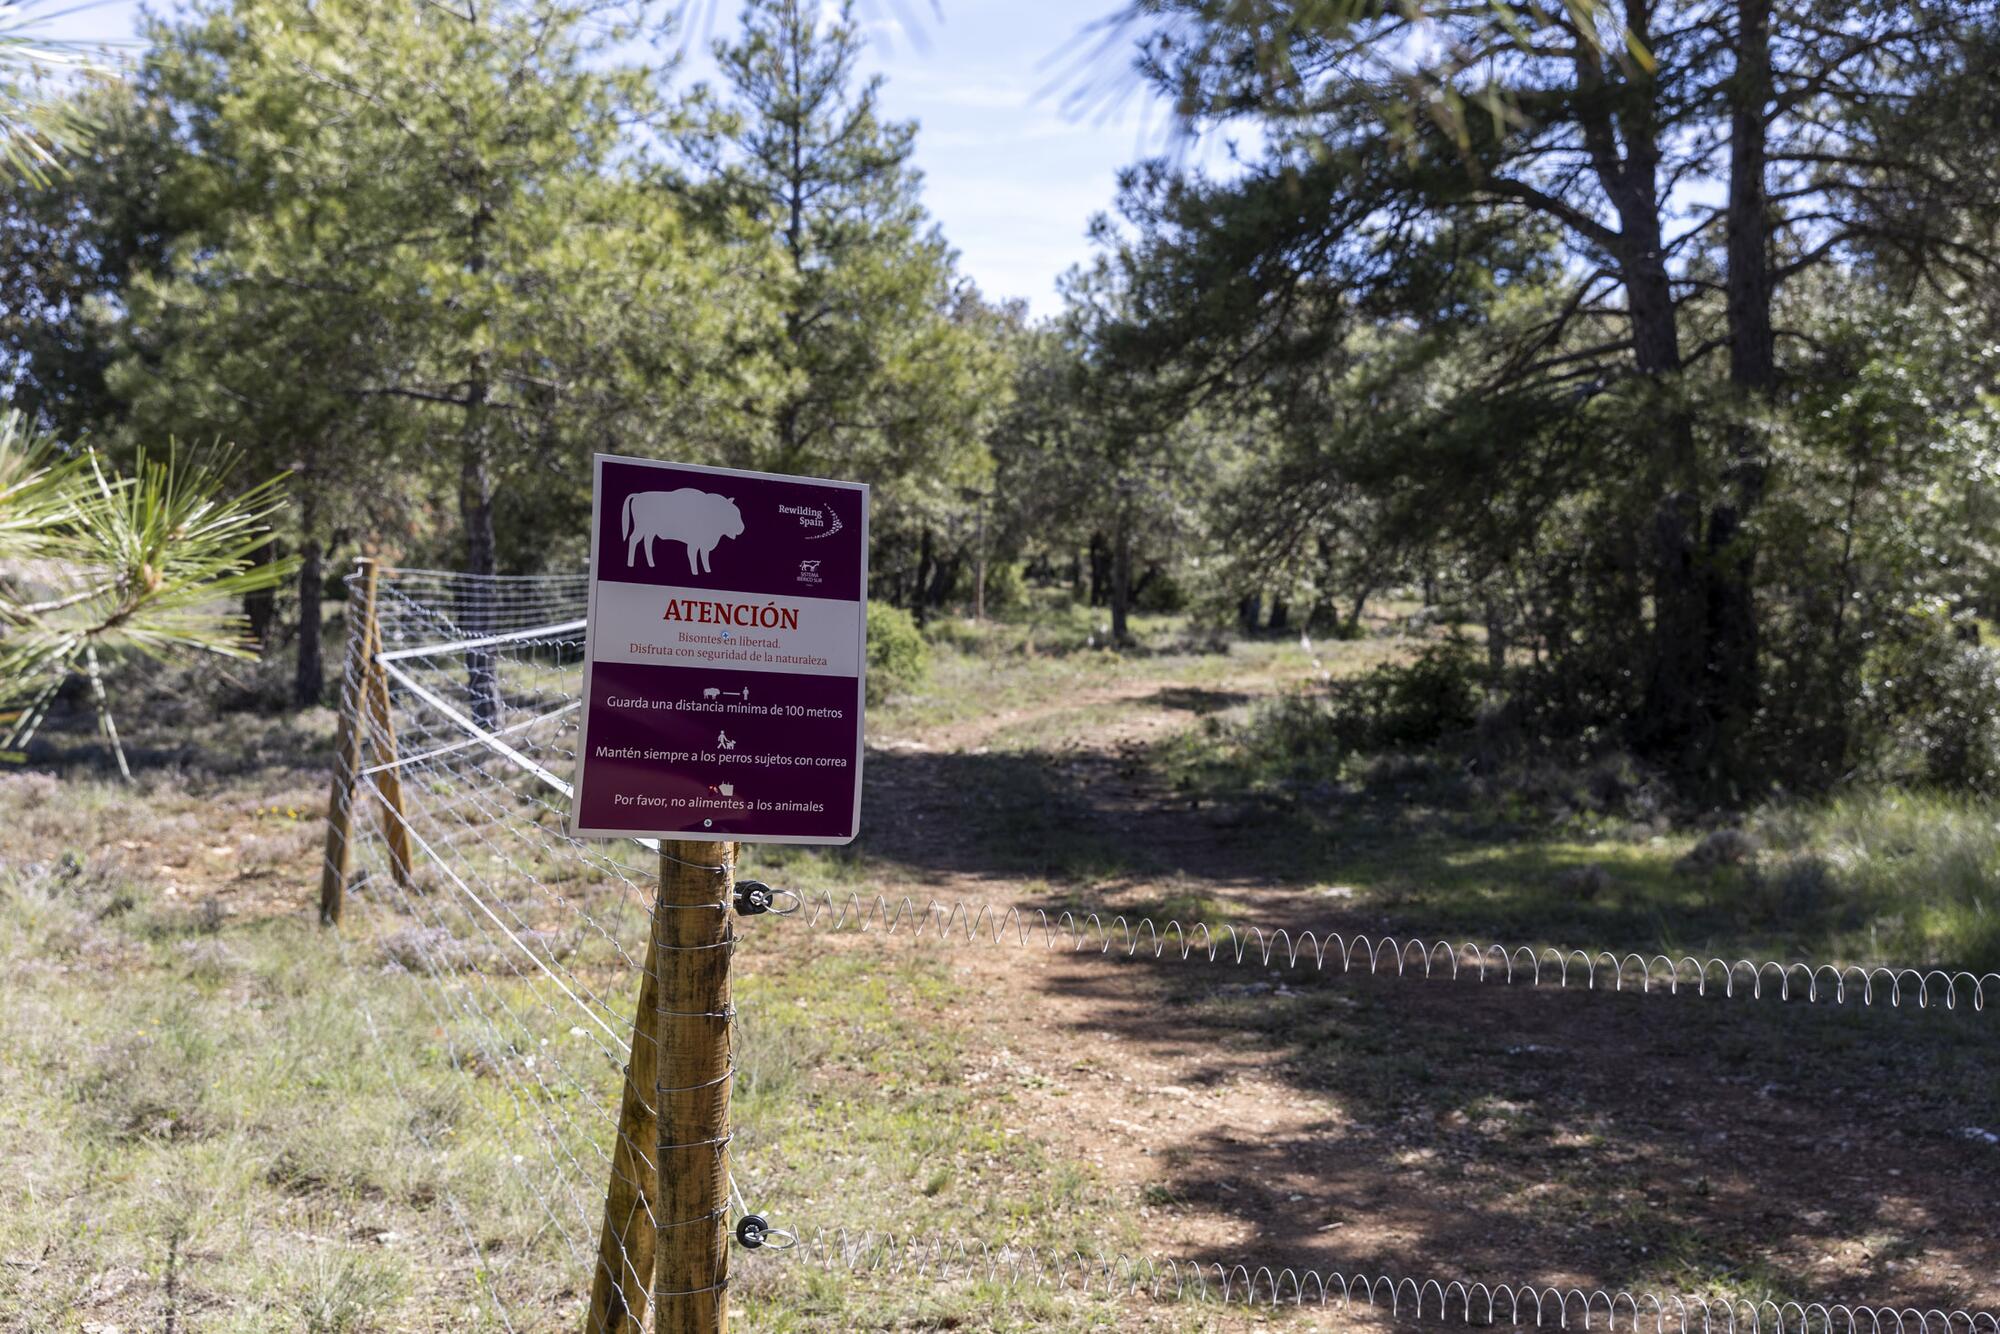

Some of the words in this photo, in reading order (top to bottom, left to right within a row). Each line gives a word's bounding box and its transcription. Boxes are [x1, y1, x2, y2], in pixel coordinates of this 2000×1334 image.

[779, 504, 822, 519] Rewilding
[800, 517, 824, 528] Spain
[663, 599, 800, 630] ATENCIÓN
[678, 632, 722, 644] Bisontes
[723, 637, 736, 646] en
[739, 636, 780, 649] libertad.
[630, 644, 673, 656] Disfruta
[675, 648, 695, 657] con
[697, 648, 748, 661] seguridad
[750, 651, 762, 662] de
[764, 652, 774, 663] la
[775, 653, 828, 666] naturaleza
[608, 696, 648, 708] Guarda
[652, 700, 673, 710] una
[676, 700, 724, 712] distancia
[727, 702, 768, 714] mínima
[770, 704, 783, 715] de
[785, 706, 804, 716] 100
[806, 708, 842, 718] metros
[596, 746, 641, 758] Mantén
[644, 748, 689, 763] siempre
[700, 750, 716, 762] los
[718, 754, 752, 765] perros
[754, 753, 792, 767] sujetos
[794, 757, 812, 766] con
[815, 758, 847, 766] correa
[614, 794, 634, 805] Por
[636, 795, 668, 808] favor,
[671, 798, 686, 807] no
[688, 797, 744, 810] alimentes
[747, 802, 754, 810] a
[757, 800, 772, 810] los
[775, 801, 824, 812] animales
